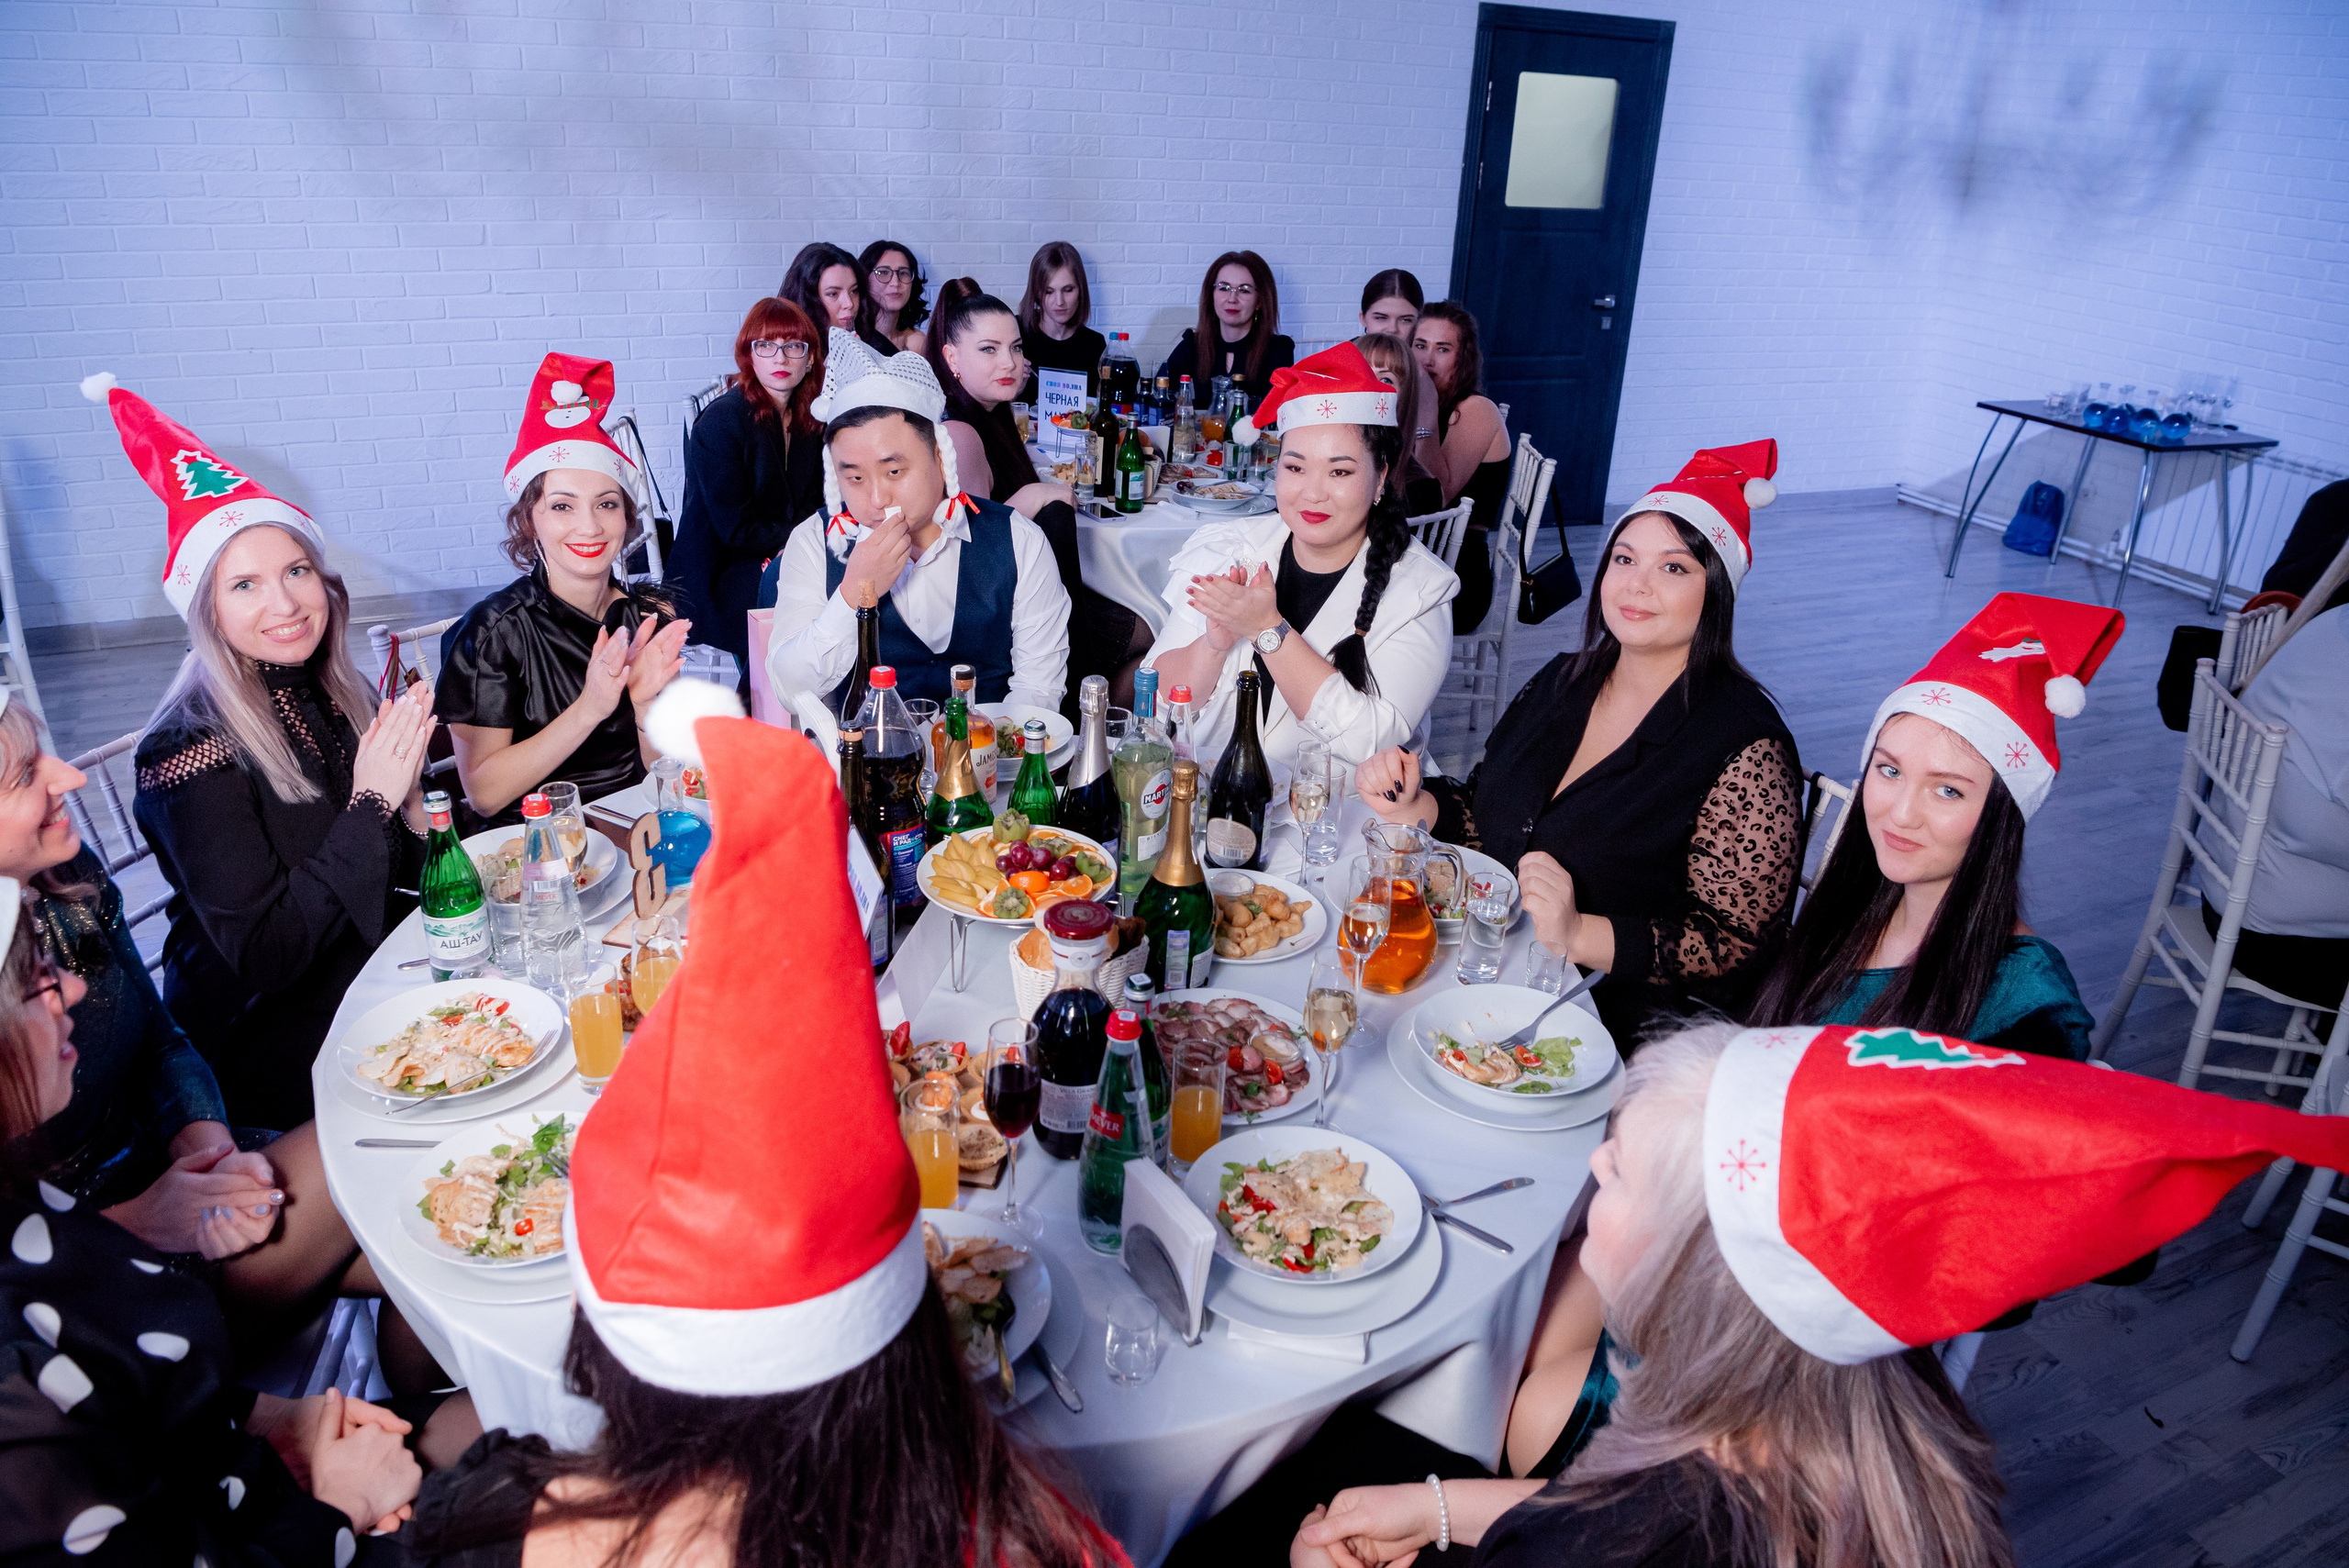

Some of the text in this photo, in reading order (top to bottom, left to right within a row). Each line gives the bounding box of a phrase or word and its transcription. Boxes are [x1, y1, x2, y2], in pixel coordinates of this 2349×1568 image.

[1045, 392, 1079, 406] ЧЕРНАЯ
[893, 833, 909, 841] СНЕГ
[440, 931, 483, 949] АШ-ТАУ
[1091, 1112, 1119, 1133] MEVER
